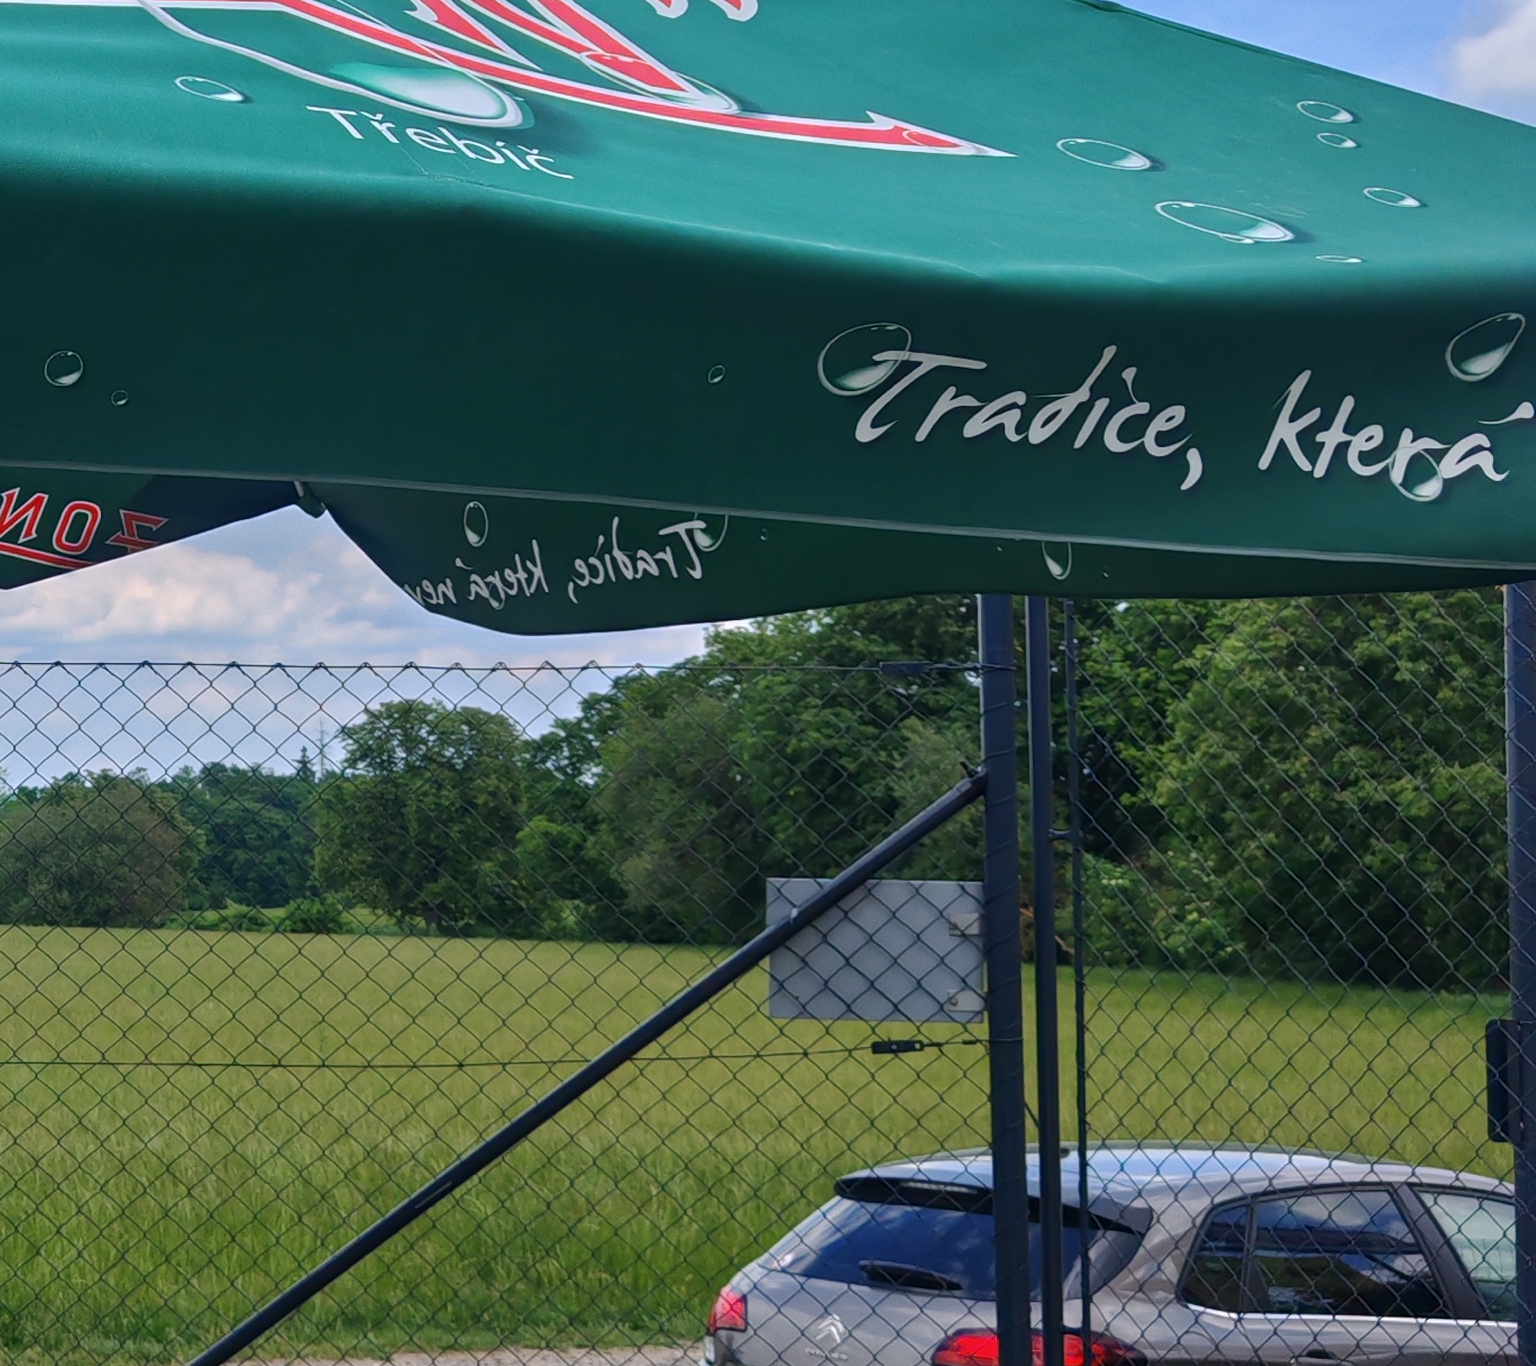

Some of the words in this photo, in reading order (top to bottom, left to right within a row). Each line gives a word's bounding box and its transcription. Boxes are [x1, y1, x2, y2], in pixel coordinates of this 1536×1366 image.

[306, 105, 575, 179] Třebíč
[854, 344, 1204, 491] Tradice,
[1258, 369, 1535, 483] která
